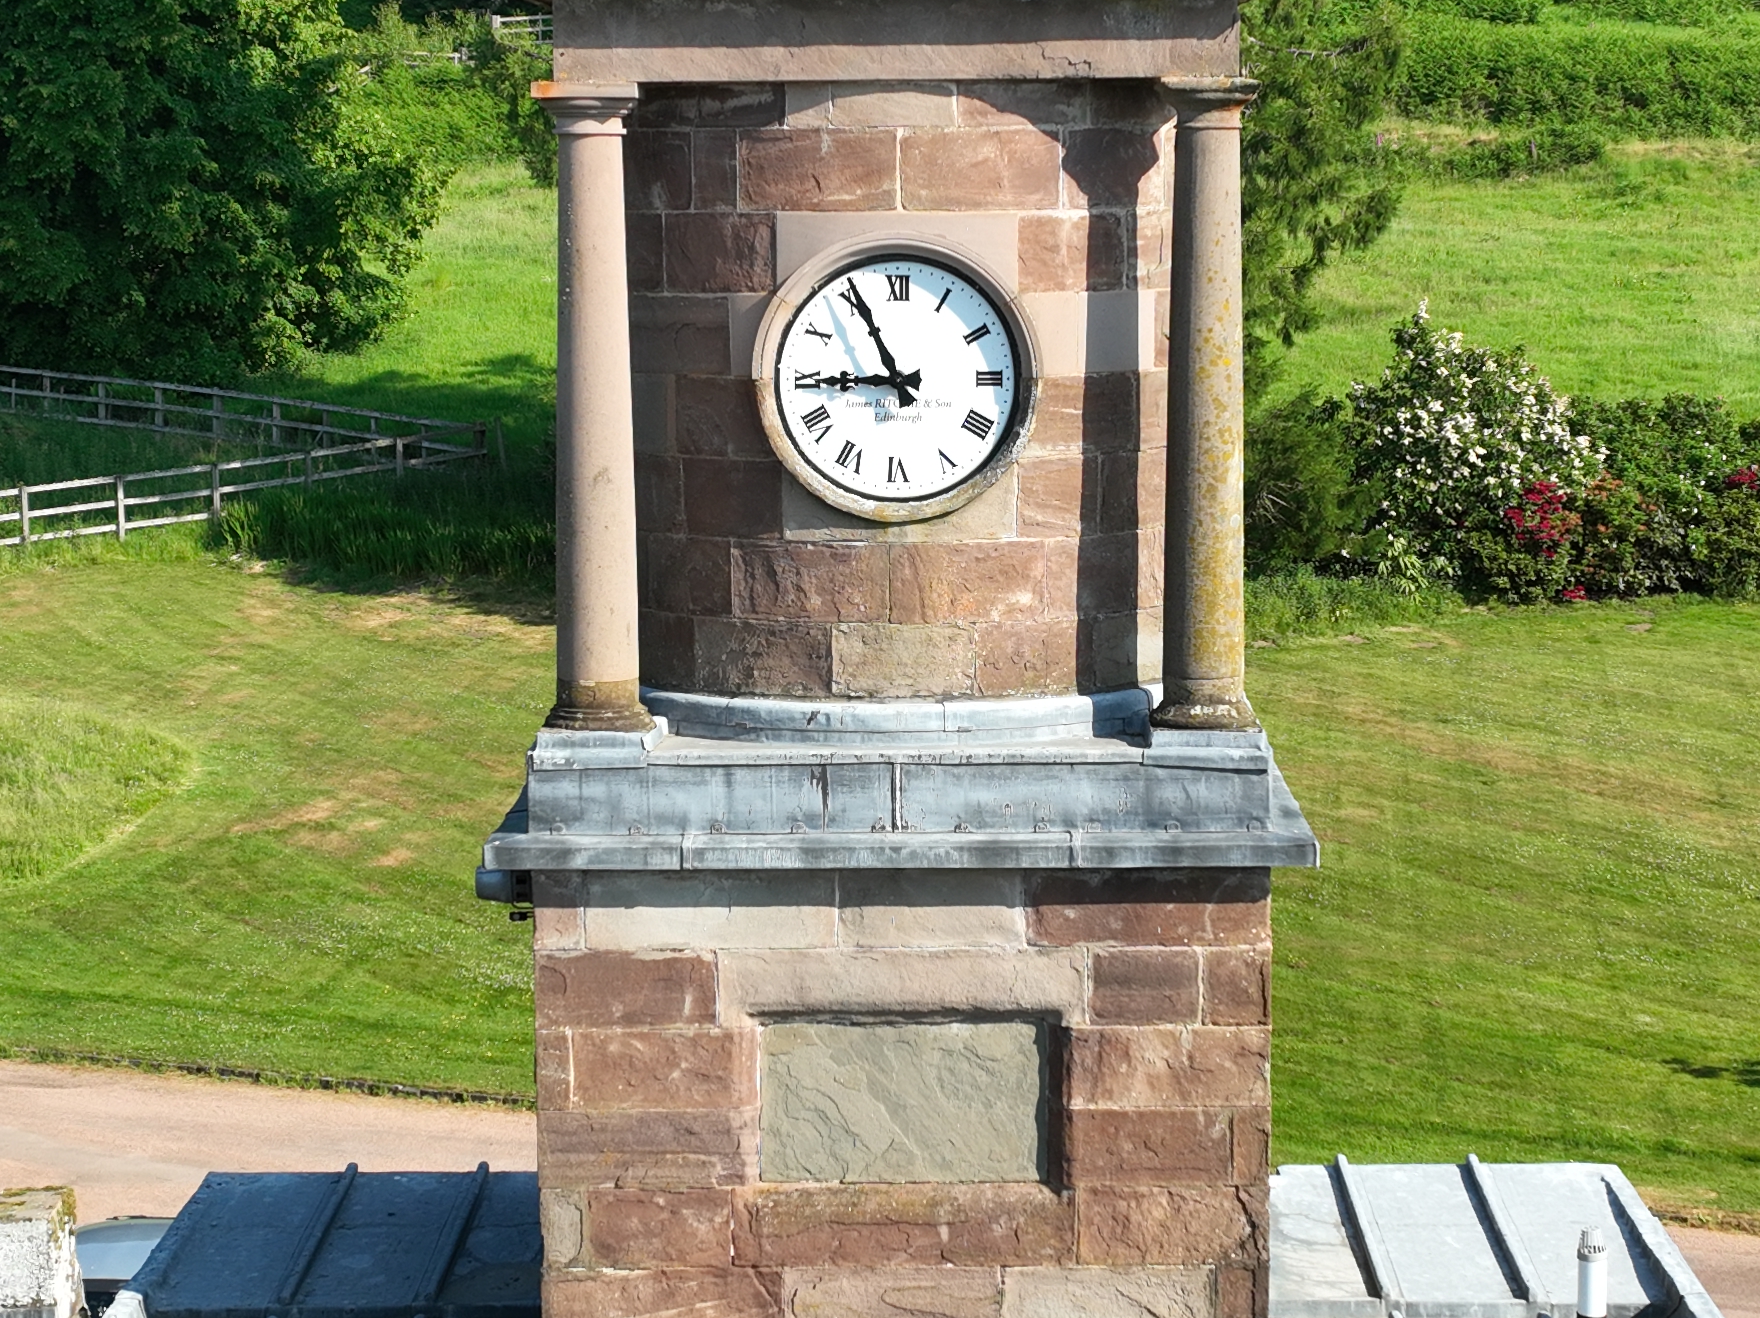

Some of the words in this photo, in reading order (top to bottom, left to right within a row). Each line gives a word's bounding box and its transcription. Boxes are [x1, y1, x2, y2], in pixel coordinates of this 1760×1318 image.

[885, 275, 911, 301] XII
[934, 287, 952, 313] I
[804, 322, 833, 346] X
[962, 323, 991, 346] II
[976, 370, 1003, 388] III
[845, 399, 873, 408] James
[875, 398, 921, 408] RITCIE
[923, 398, 933, 408] &
[935, 398, 952, 408] Son
[800, 403, 834, 445] VIII
[874, 412, 922, 424] Edinburgh
[961, 407, 995, 441] IIII
[835, 440, 863, 475] VII
[886, 456, 911, 483] VI
[938, 448, 959, 474] V
